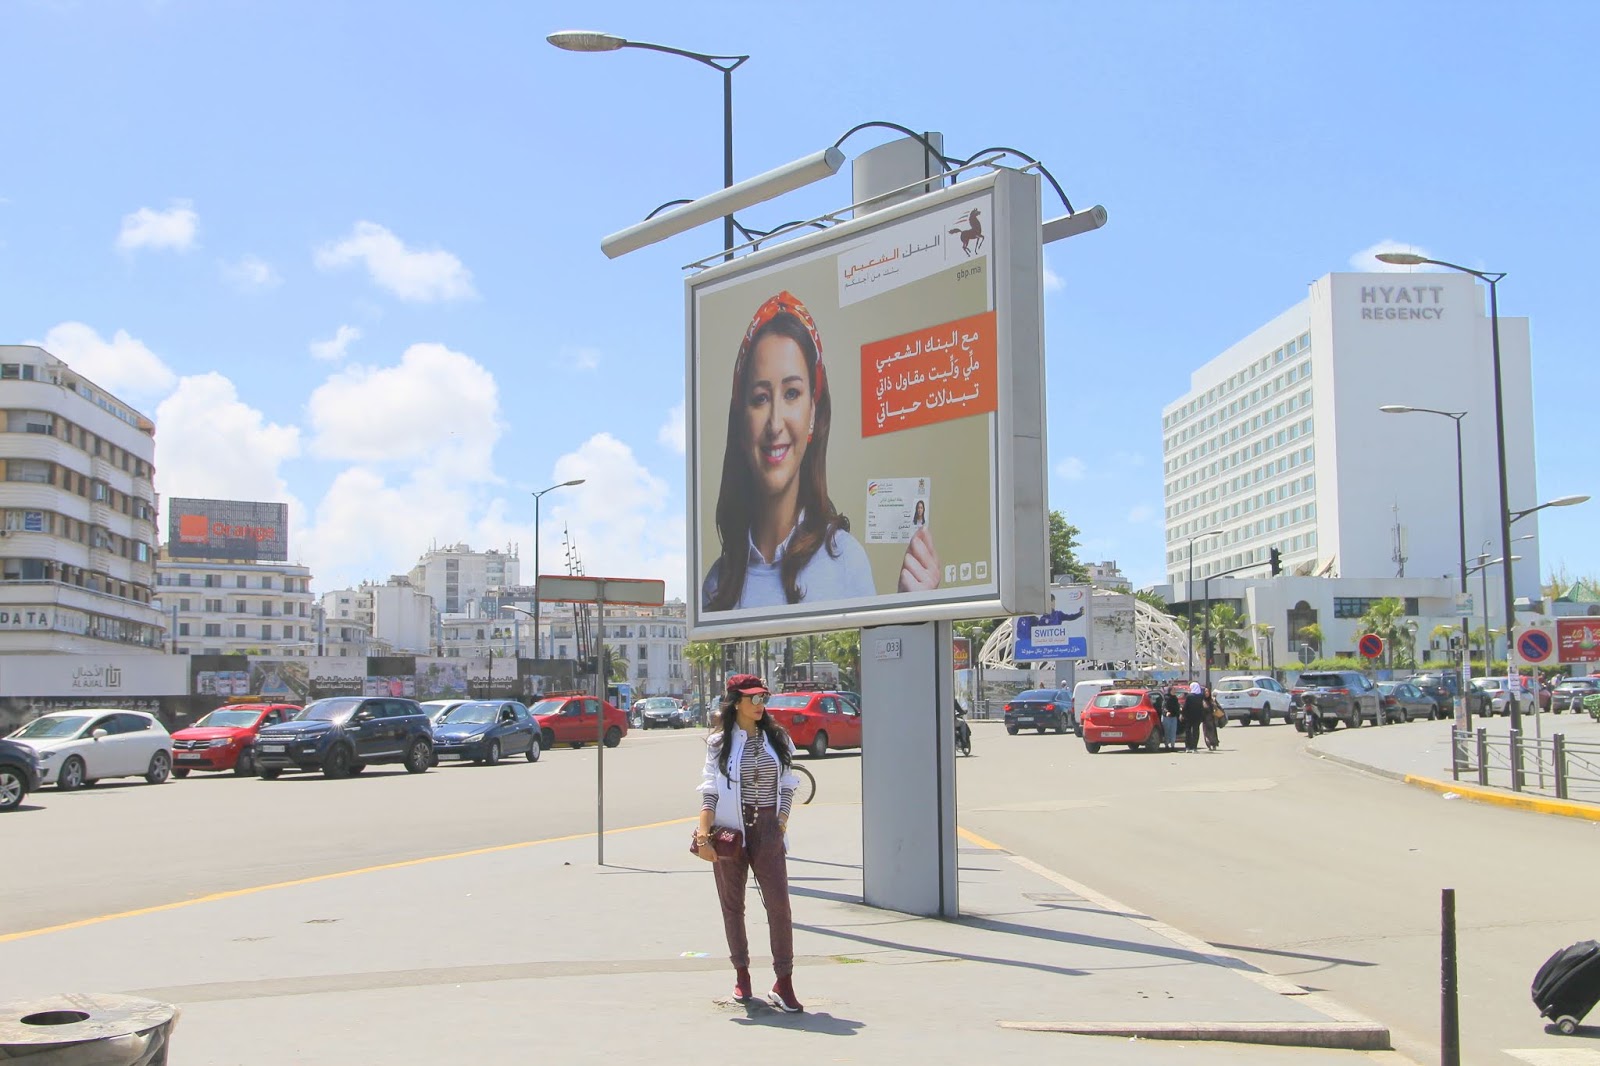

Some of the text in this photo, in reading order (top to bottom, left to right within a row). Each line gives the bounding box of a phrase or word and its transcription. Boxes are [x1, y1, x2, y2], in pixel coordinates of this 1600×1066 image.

[844, 235, 940, 279] البنك الشعبي
[956, 265, 982, 281] gbp.ma
[1361, 286, 1444, 304] HYATT
[1361, 307, 1444, 320] REGENCY
[876, 330, 979, 373] مع البنك الشعبي
[876, 376, 893, 401] ذاتي
[895, 370, 925, 391] مقاول
[876, 383, 980, 428] تبدلات حياتي
[1034, 627, 1066, 638] SWITCH
[886, 641, 900, 653] 033
[72, 679, 82, 688] AL
